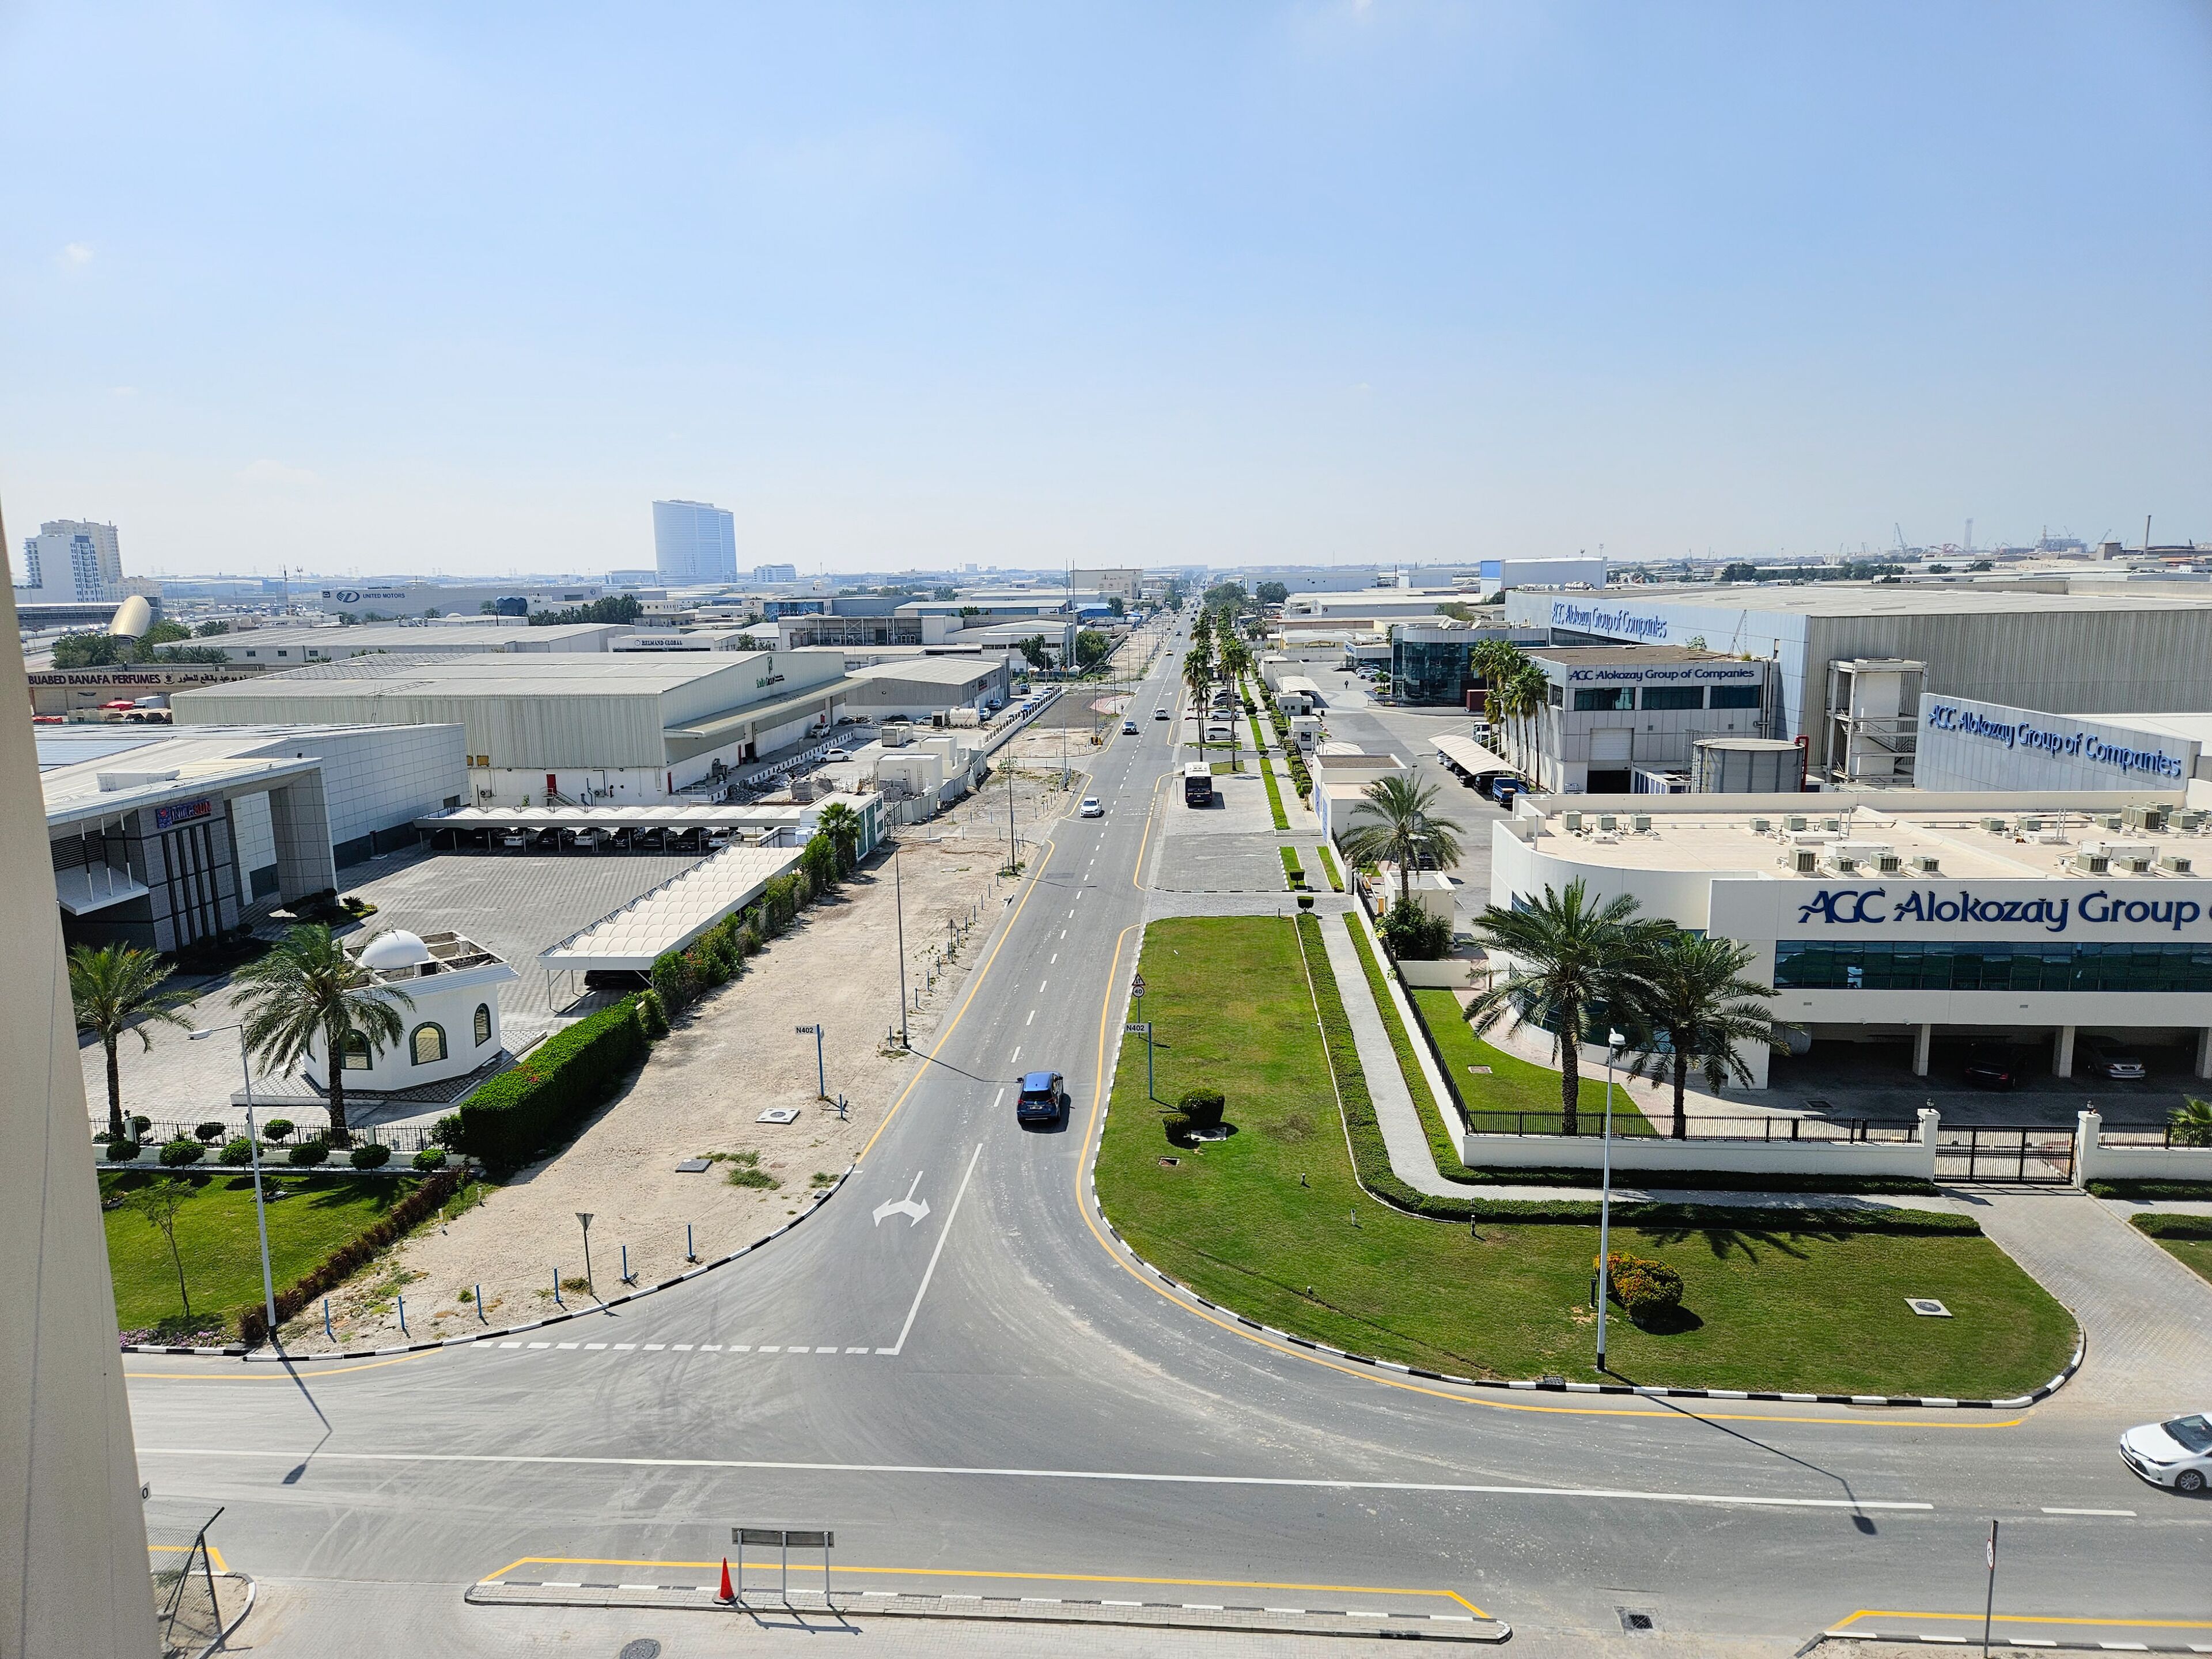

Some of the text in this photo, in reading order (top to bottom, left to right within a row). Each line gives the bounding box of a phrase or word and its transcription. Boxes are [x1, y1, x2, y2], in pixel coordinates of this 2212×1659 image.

[1593, 607, 1613, 635] Group
[1614, 609, 1622, 631] of
[1623, 611, 1667, 641] Companies
[69, 675, 111, 684] BANAFA
[112, 674, 161, 684] PERFUMES
[1596, 670, 1643, 681] Alokozay
[1645, 669, 1679, 680] Group
[1681, 669, 1692, 679] of
[1695, 669, 1755, 679] Companies
[1958, 711, 2015, 748] Alokozay
[2017, 722, 2062, 756] Group
[2065, 732, 2084, 756] of
[2085, 734, 2181, 777] Companies
[1893, 891, 2069, 933] Alokozay
[2078, 892, 2200, 931] Group
